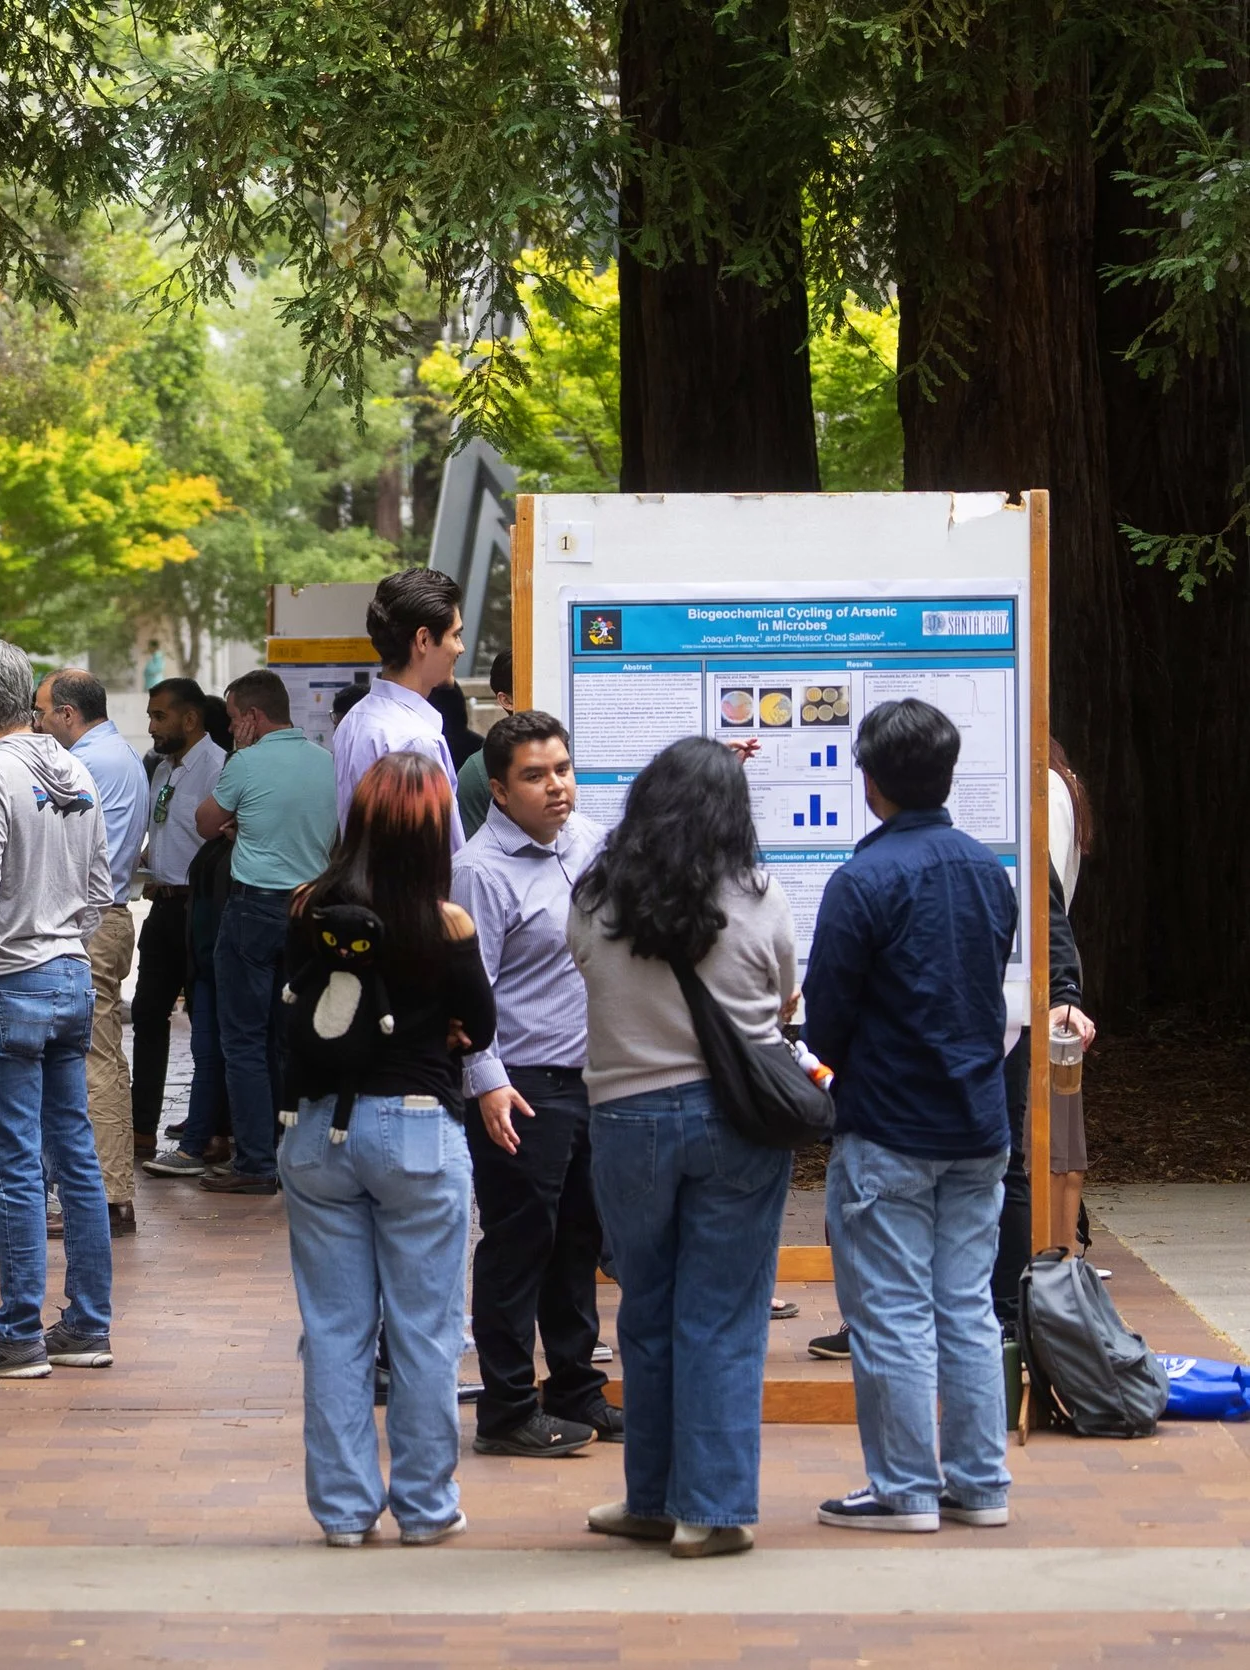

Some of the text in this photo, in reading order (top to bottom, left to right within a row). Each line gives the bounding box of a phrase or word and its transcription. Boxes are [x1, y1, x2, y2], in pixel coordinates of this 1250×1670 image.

[561, 536, 570, 550] 1
[688, 605, 898, 621] Biogeochemical Cycling of Arsenic
[757, 619, 828, 631] in Microbes
[948, 615, 1008, 635] SANTA CRUZ
[765, 634, 781, 643] and
[782, 633, 823, 642] Professor
[824, 633, 847, 642] Chad
[622, 663, 653, 671] Abstract
[846, 660, 873, 668] Results
